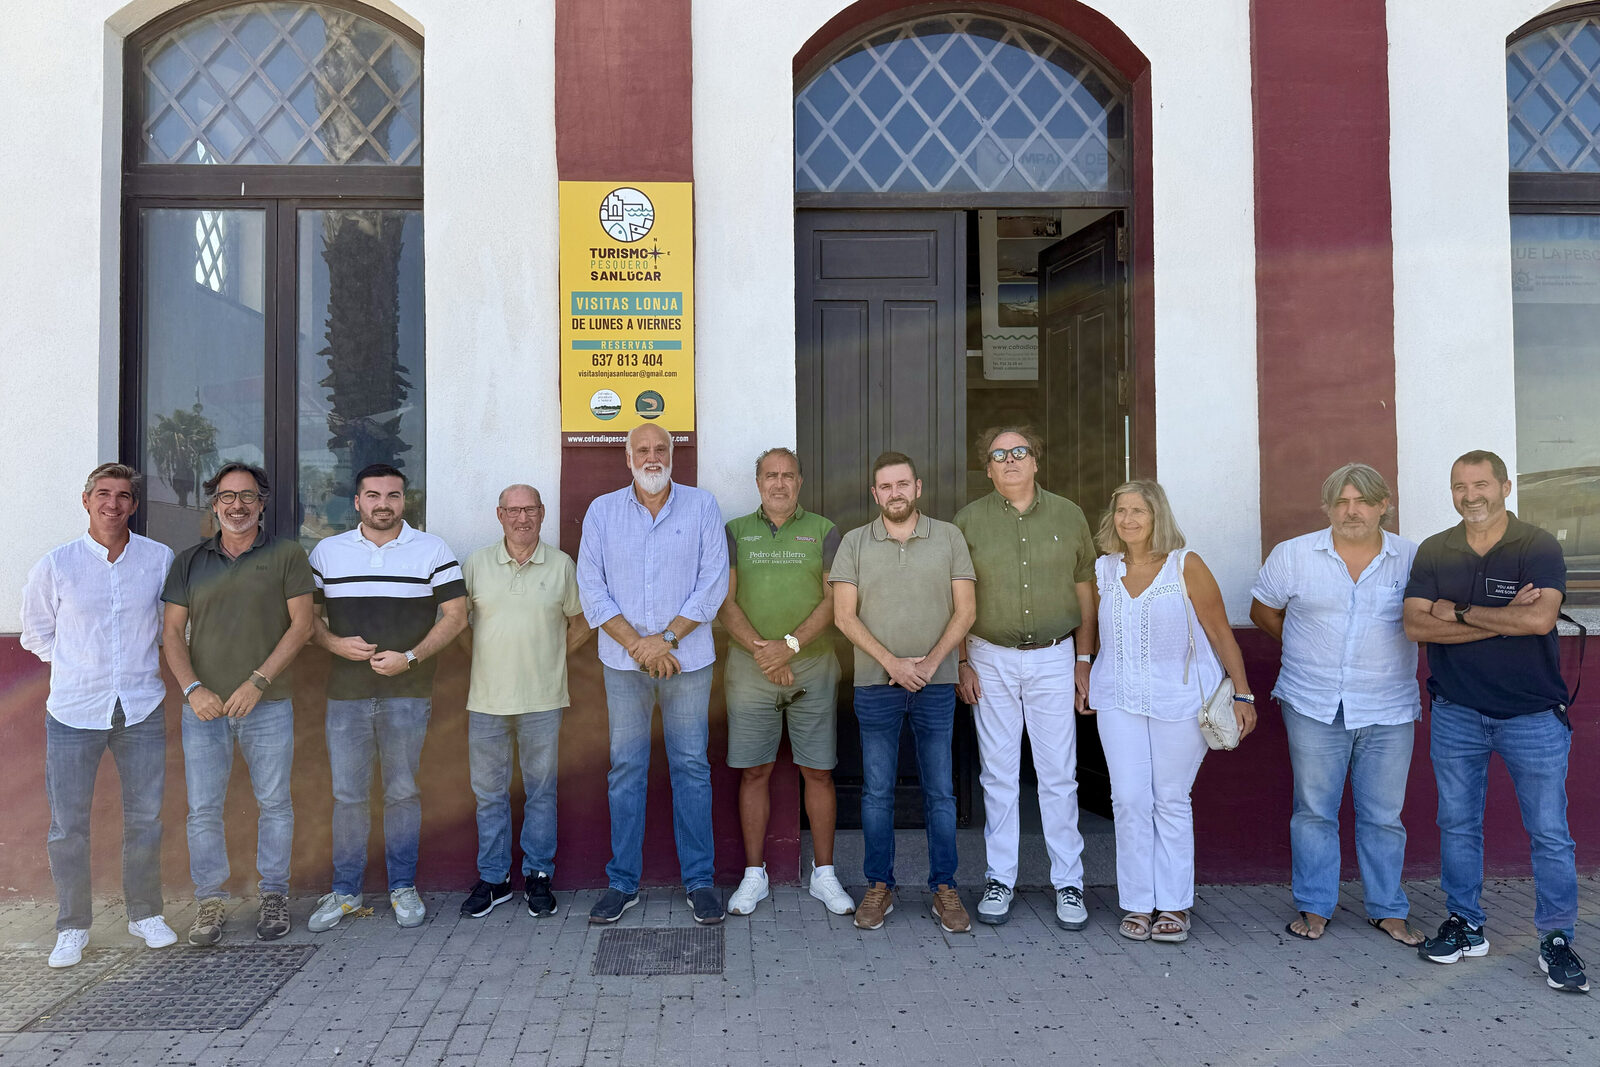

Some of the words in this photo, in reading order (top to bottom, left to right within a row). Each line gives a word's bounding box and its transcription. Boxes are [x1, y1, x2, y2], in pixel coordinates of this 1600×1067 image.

[589, 248, 648, 259] TURISMO
[591, 260, 649, 270] PESQUERO
[576, 297, 629, 310] VISITAS
[636, 297, 678, 310] LONJA
[572, 318, 586, 330] DE
[589, 318, 623, 330] LUNES
[627, 318, 634, 330] A
[637, 318, 681, 330] VIERNES
[601, 341, 654, 350] RESERVAS
[592, 353, 613, 366] 637
[617, 353, 638, 366] 813
[642, 353, 663, 366] 404
[578, 370, 678, 378] visitaslonjasanlucar@gmail.com
